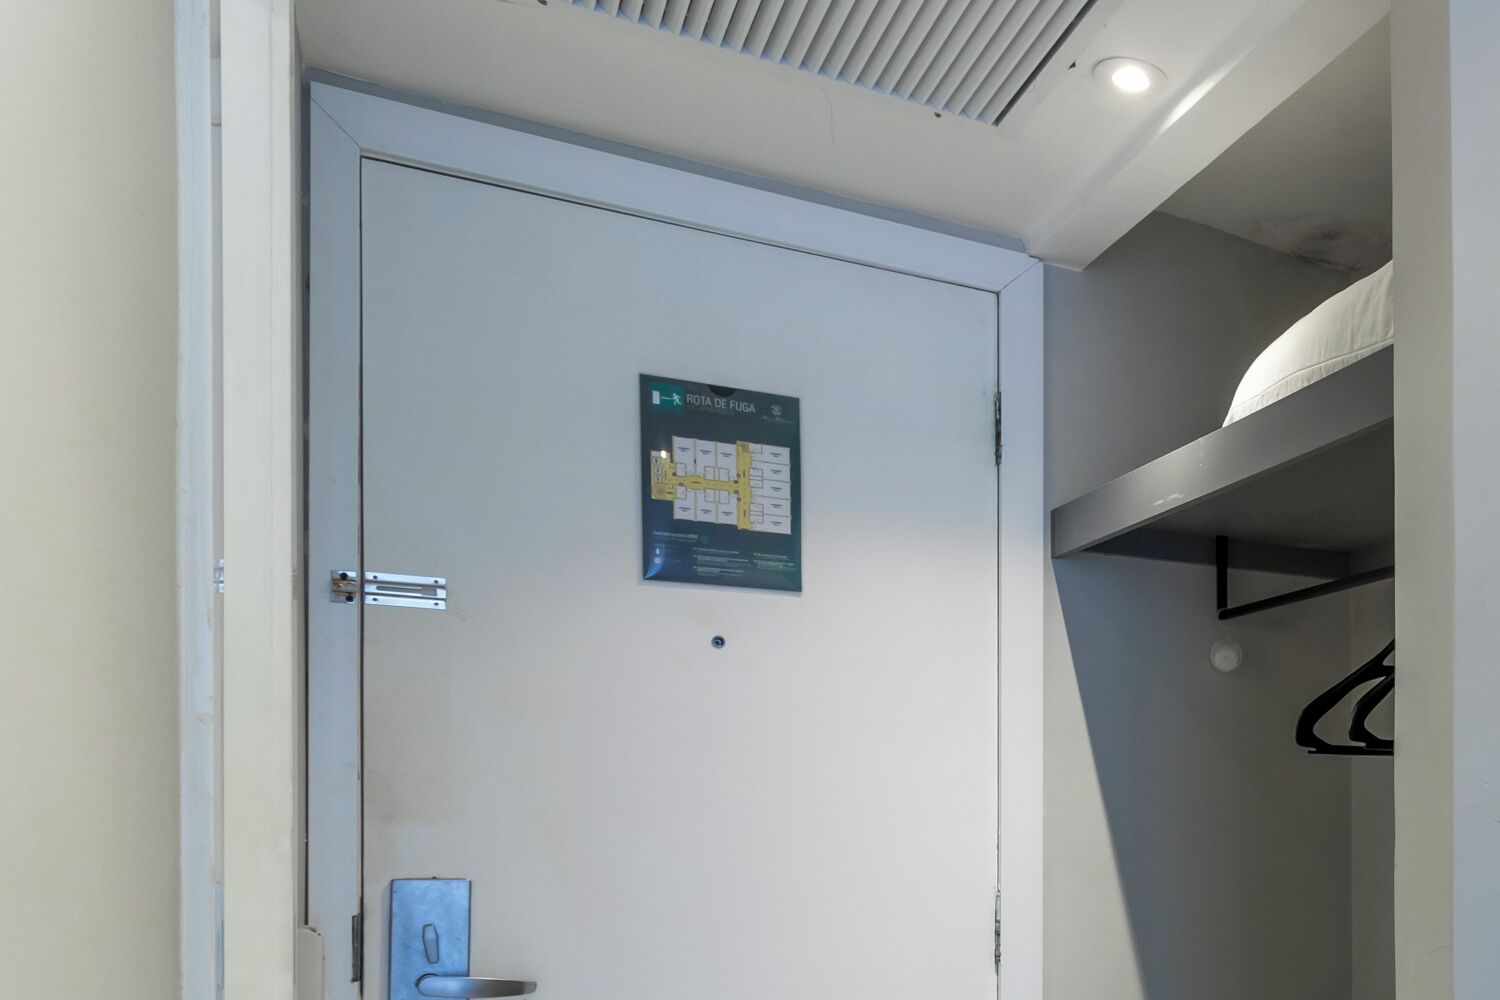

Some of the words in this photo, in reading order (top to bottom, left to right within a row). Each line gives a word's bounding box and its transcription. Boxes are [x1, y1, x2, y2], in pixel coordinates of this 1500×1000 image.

[686, 393, 712, 406] ROTA
[714, 397, 728, 409] DE
[729, 400, 756, 414] FUGA
